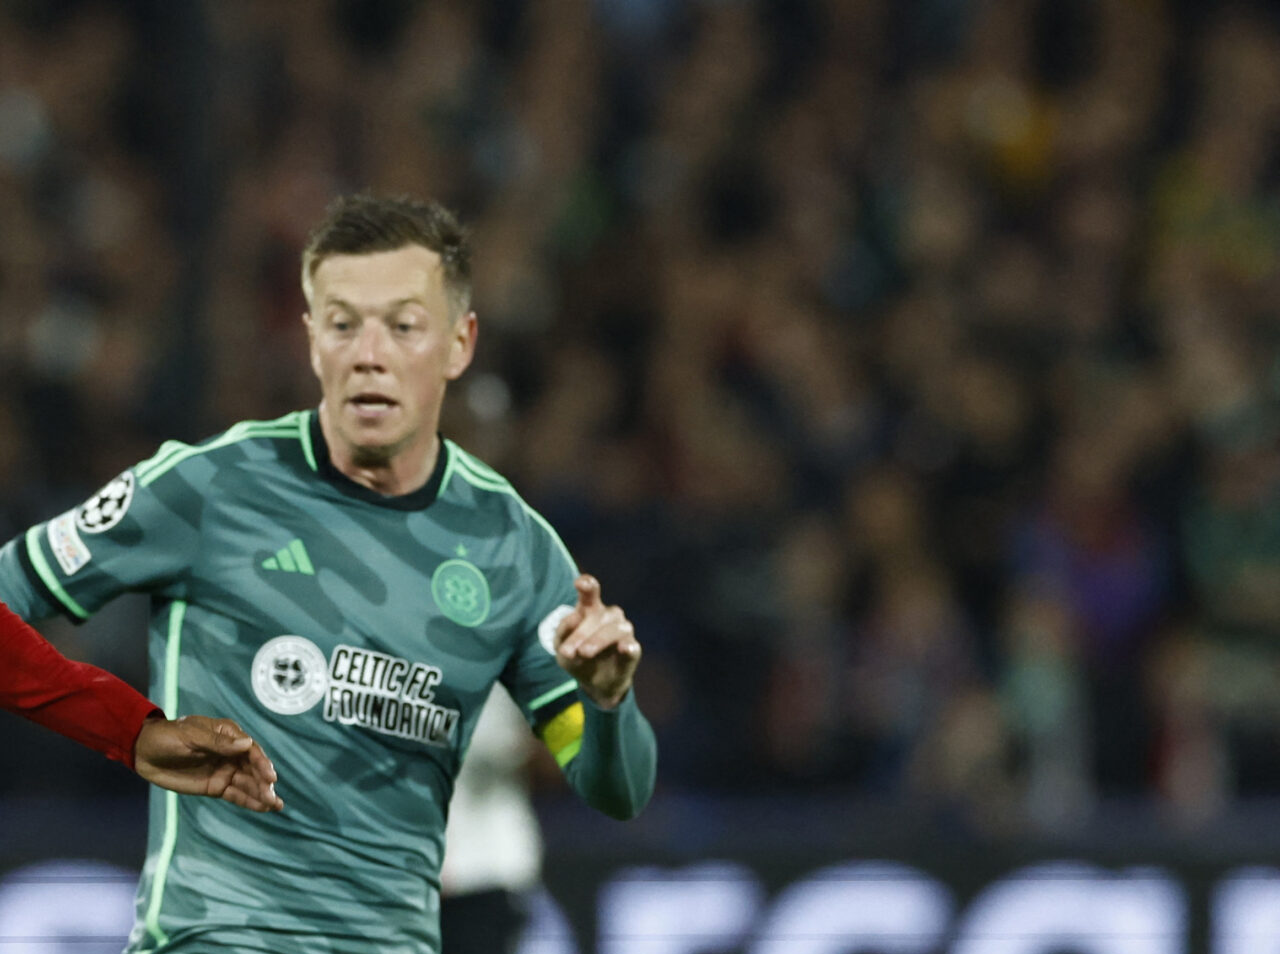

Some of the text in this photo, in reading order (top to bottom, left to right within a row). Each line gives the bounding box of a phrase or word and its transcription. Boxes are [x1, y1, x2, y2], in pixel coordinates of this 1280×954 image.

[331, 648, 405, 692] CELTIC
[406, 666, 438, 700] FC
[327, 686, 457, 741] FOUNDATION
